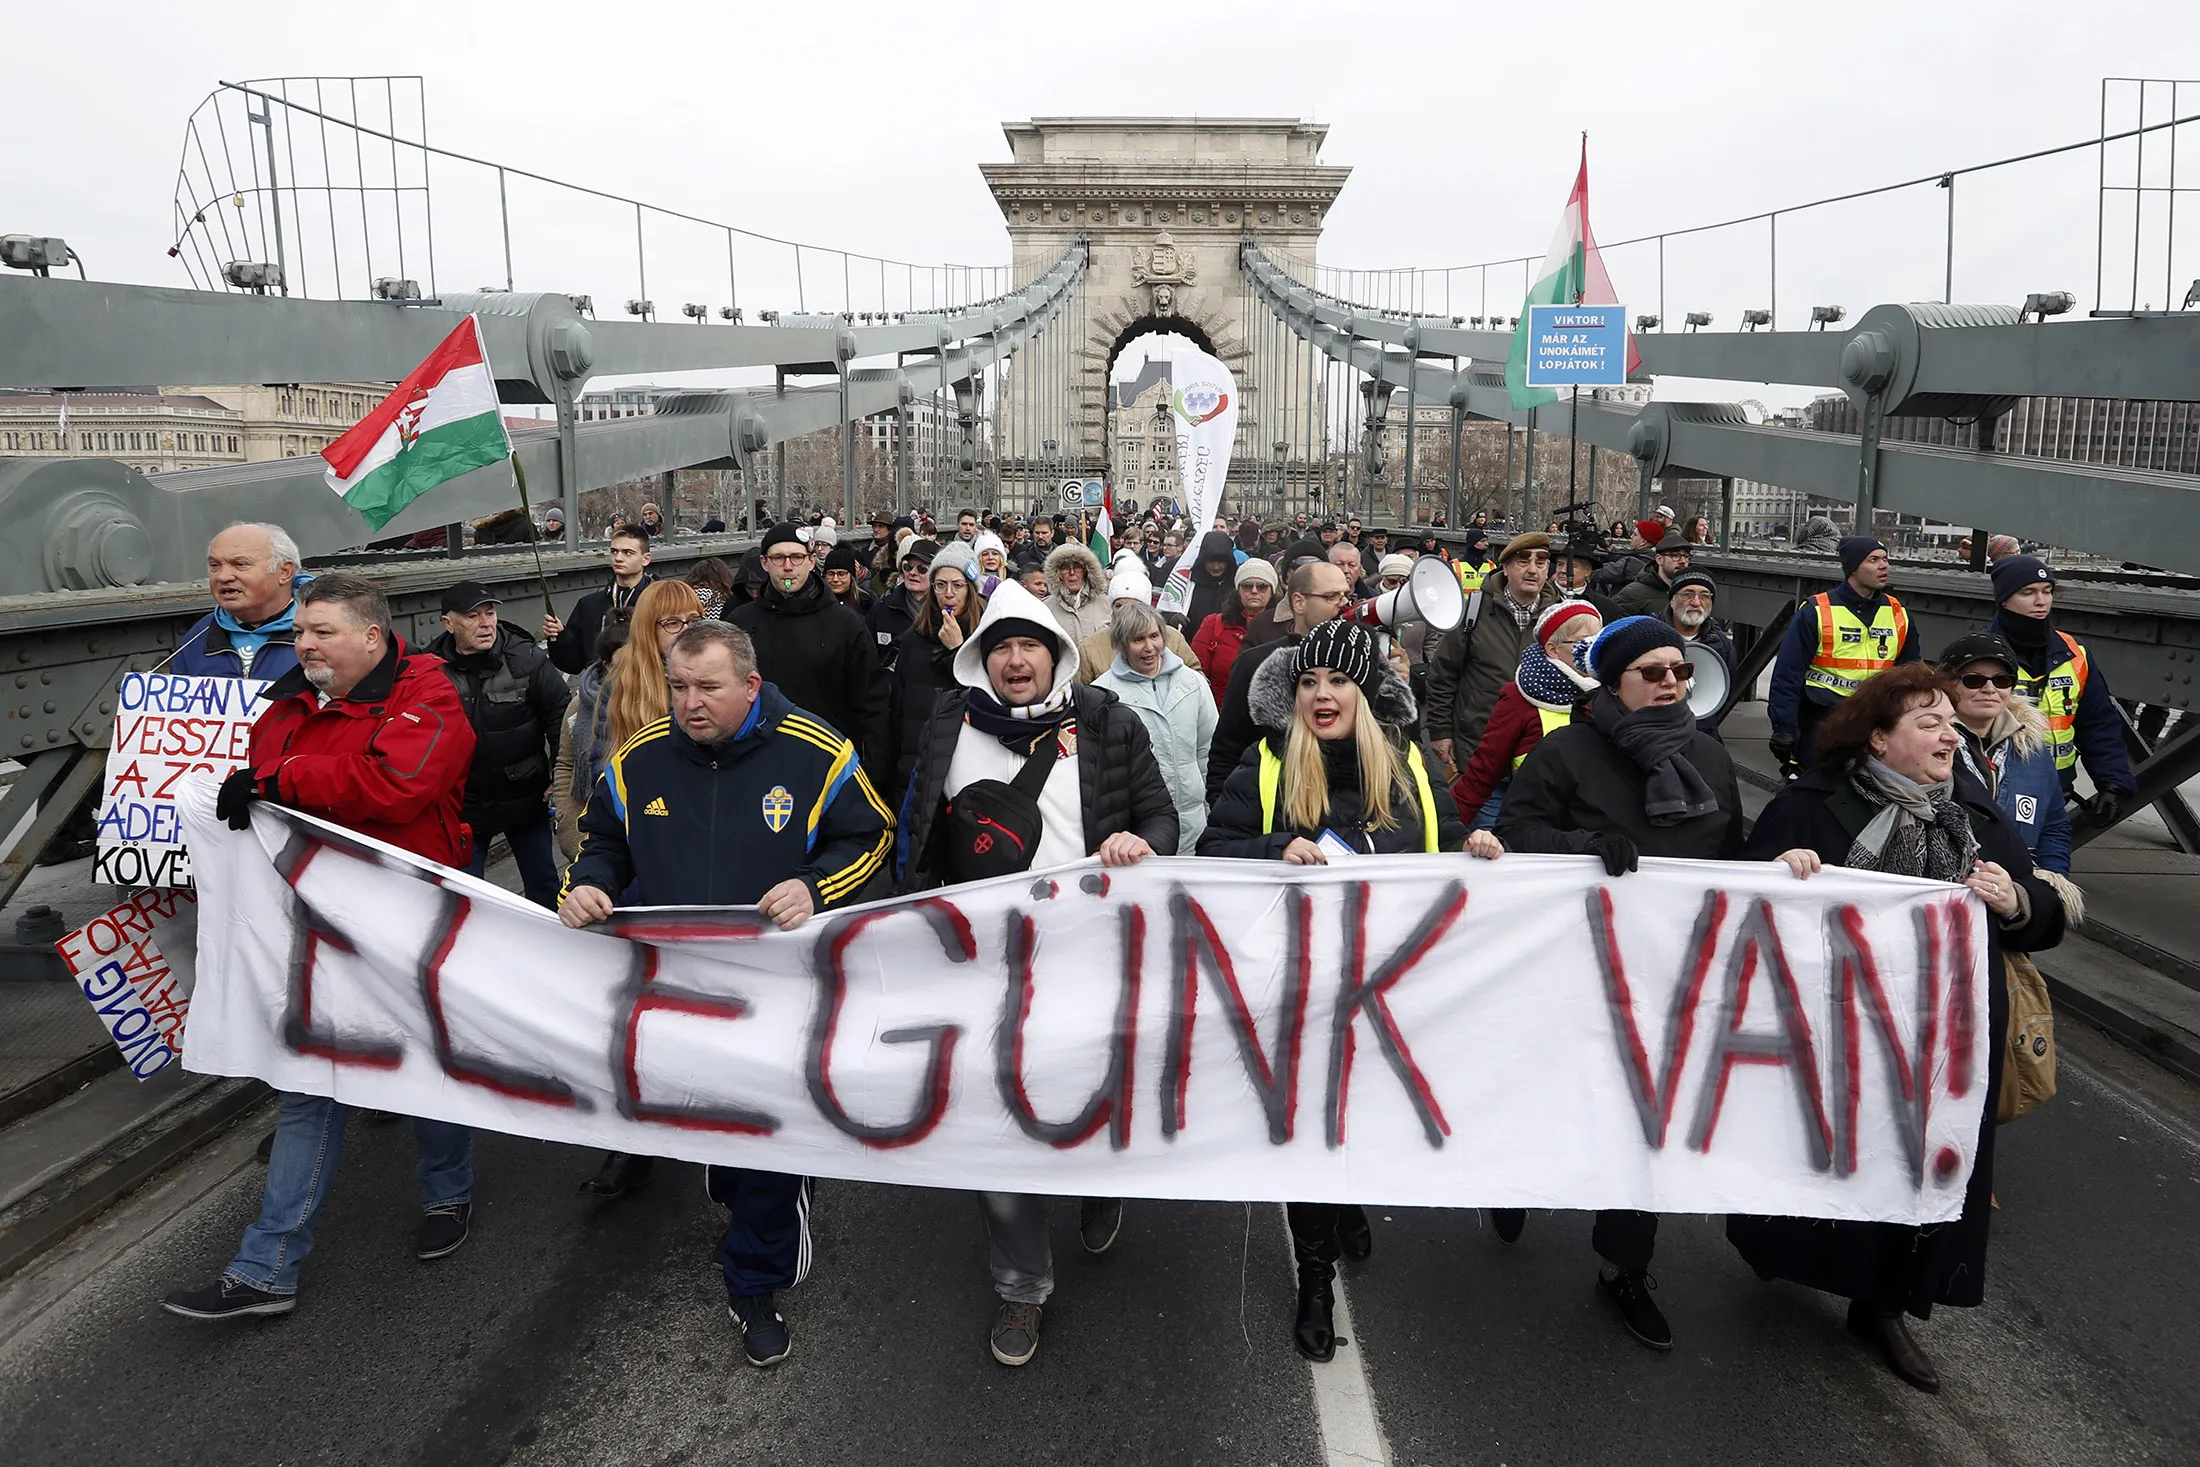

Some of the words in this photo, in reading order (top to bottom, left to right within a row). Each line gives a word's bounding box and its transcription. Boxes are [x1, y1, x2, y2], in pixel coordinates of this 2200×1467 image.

[1541, 333, 1568, 343] MÁR
[1571, 335, 1588, 343] AZ
[1539, 345, 1606, 356] UNOKÁIMÉT
[1870, 628, 1893, 637] POLICE
[2050, 677, 2074, 688] POLICE
[121, 673, 232, 716] ORBÁN
[237, 679, 268, 717] V.
[643, 808, 669, 817] adidas
[92, 841, 197, 888] KÖVÉ
[273, 818, 1468, 1149] ELEGÜNK
